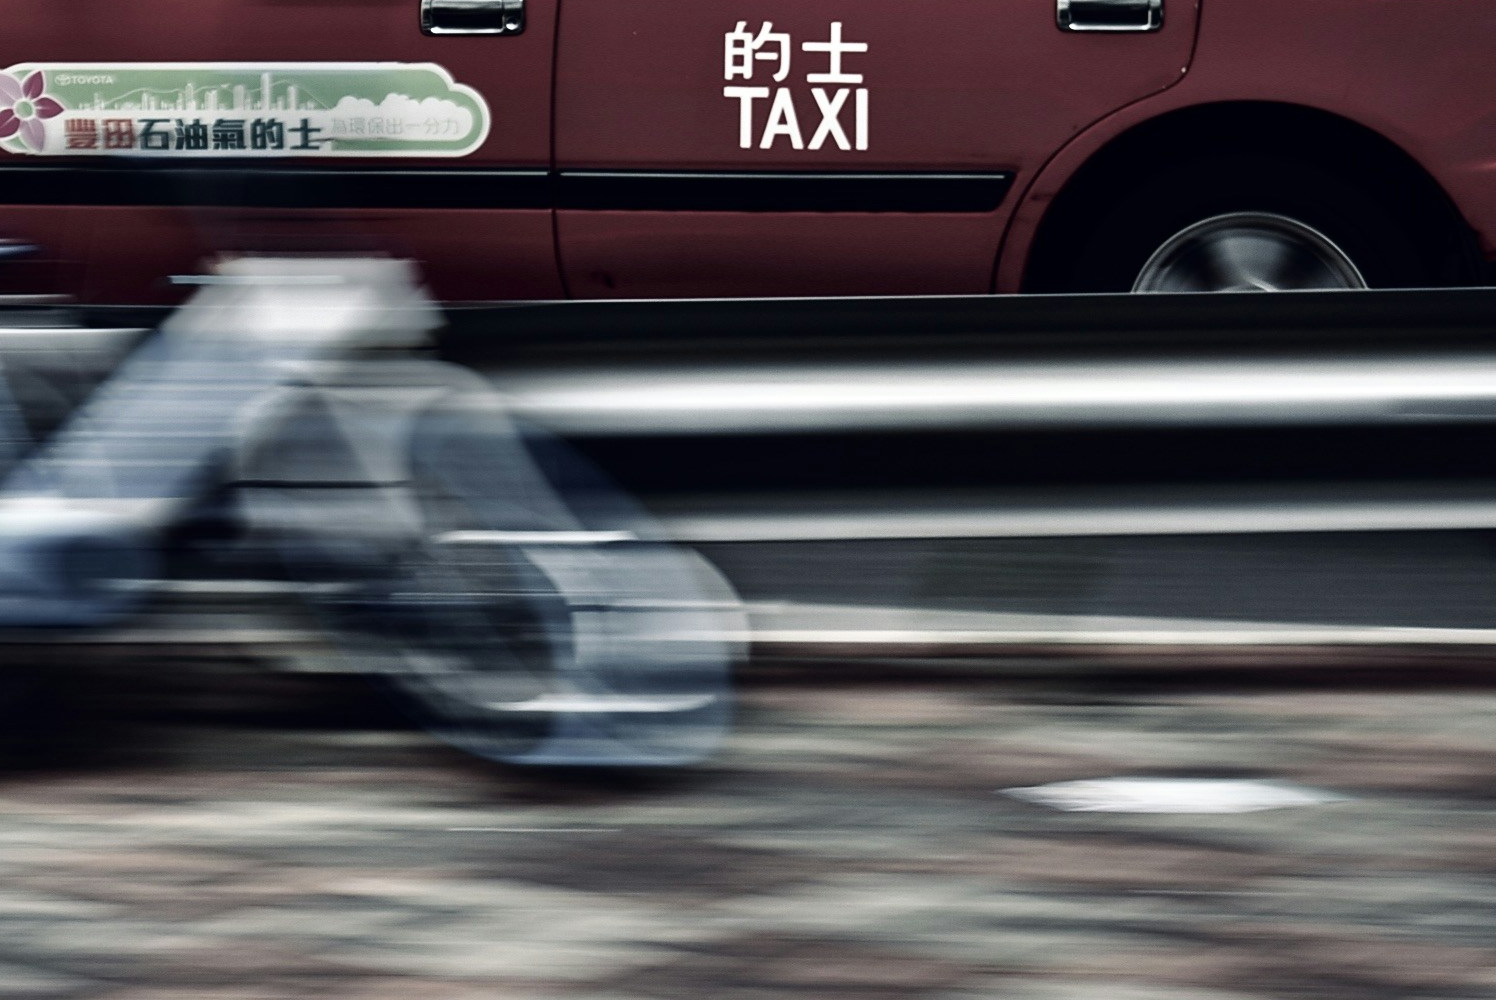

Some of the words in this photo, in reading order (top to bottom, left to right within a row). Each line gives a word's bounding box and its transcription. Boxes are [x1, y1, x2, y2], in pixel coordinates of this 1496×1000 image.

[71, 75, 113, 85] TOYOTA
[724, 20, 868, 83] 的士
[723, 86, 868, 150] TAXI
